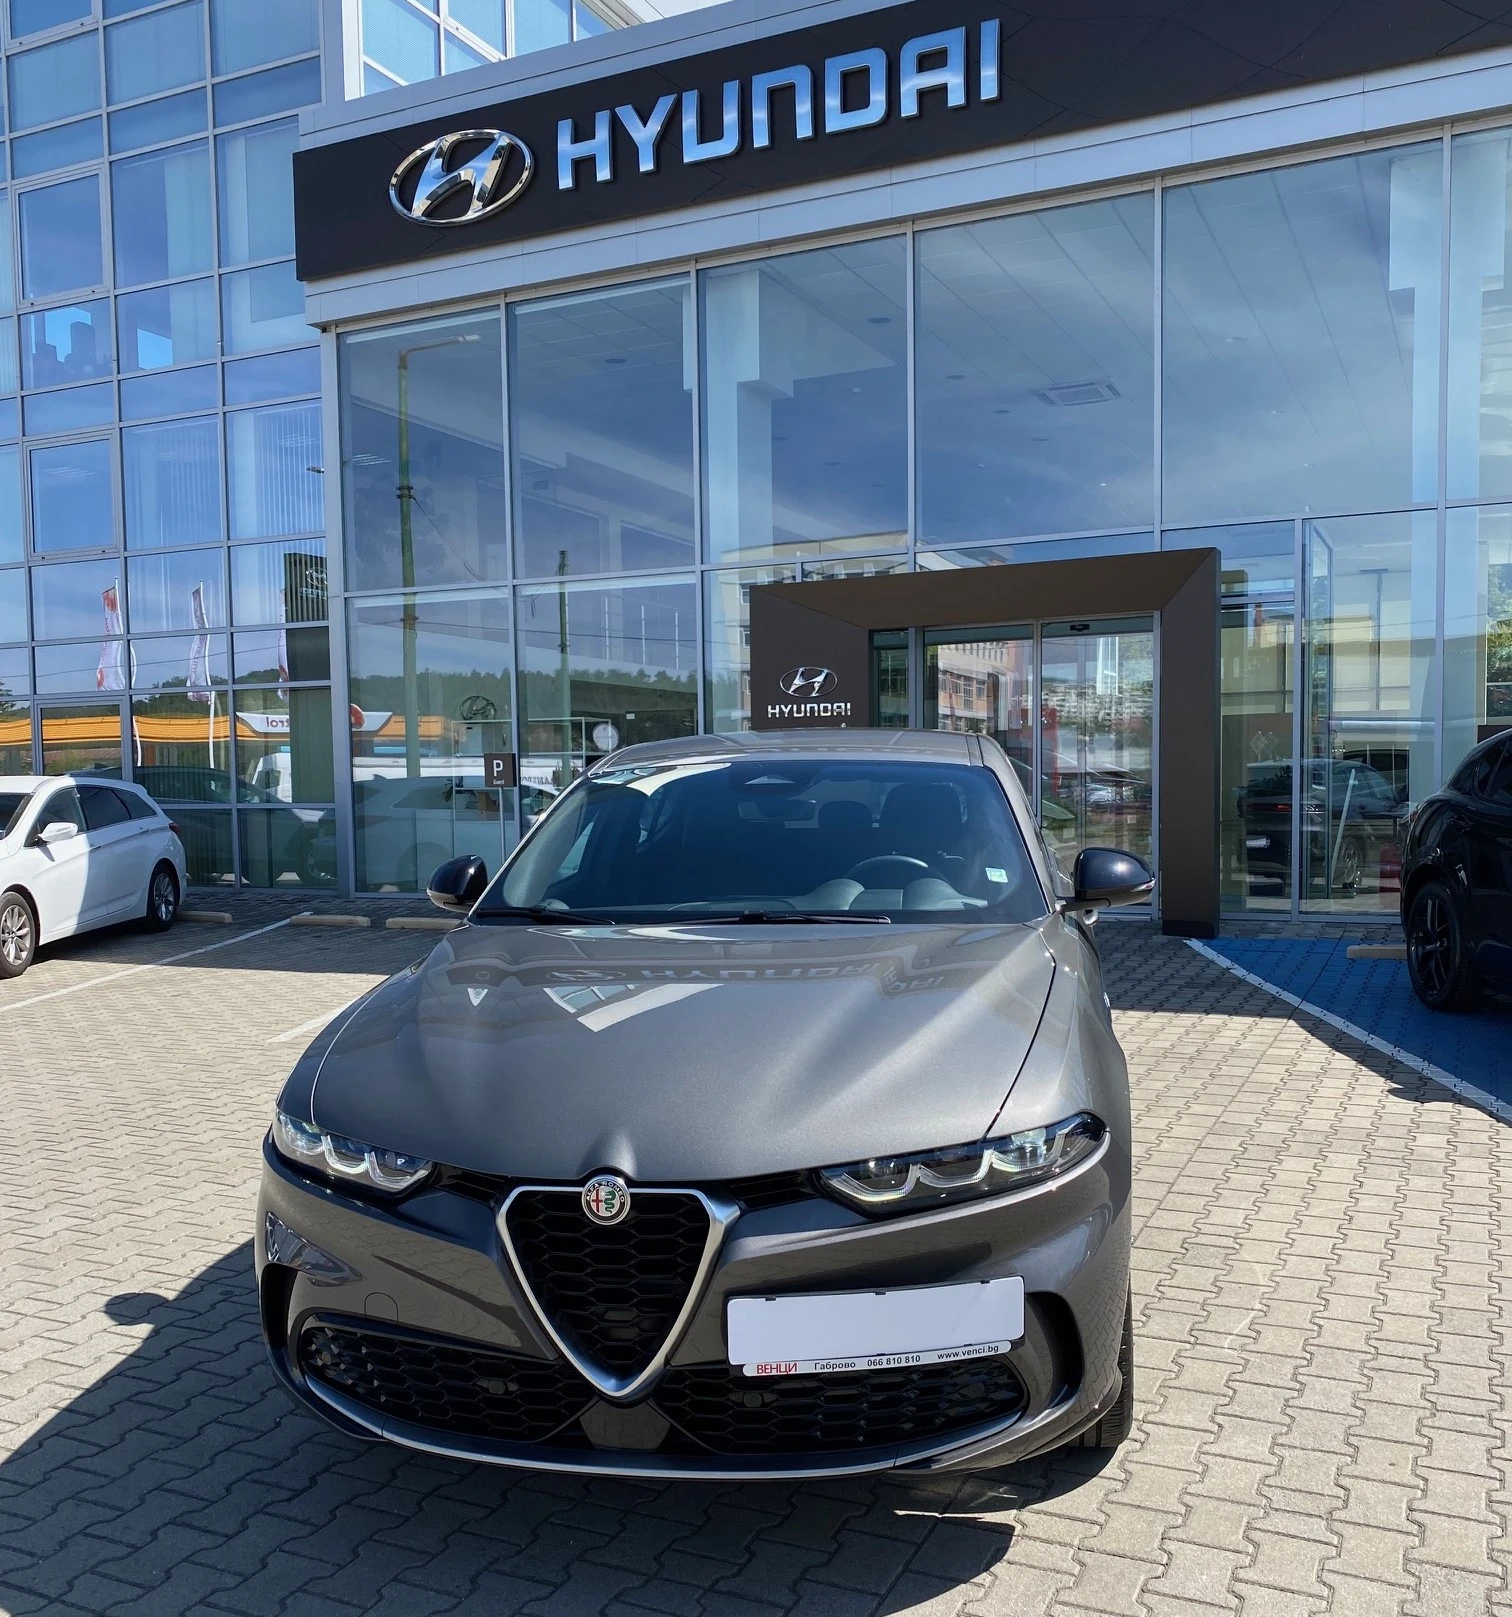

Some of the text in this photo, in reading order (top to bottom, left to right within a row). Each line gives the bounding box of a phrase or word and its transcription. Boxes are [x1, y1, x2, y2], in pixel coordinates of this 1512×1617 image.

[557, 18, 1000, 191] HYUNDAI
[767, 702, 851, 718] HYUNDAI
[493, 759, 504, 777] P
[586, 1180, 625, 1203] ALFA ROMEO
[937, 1345, 999, 1360] www.venci.bg
[756, 1354, 920, 1375] ВЕНЦИ Габрово 066 810 810
